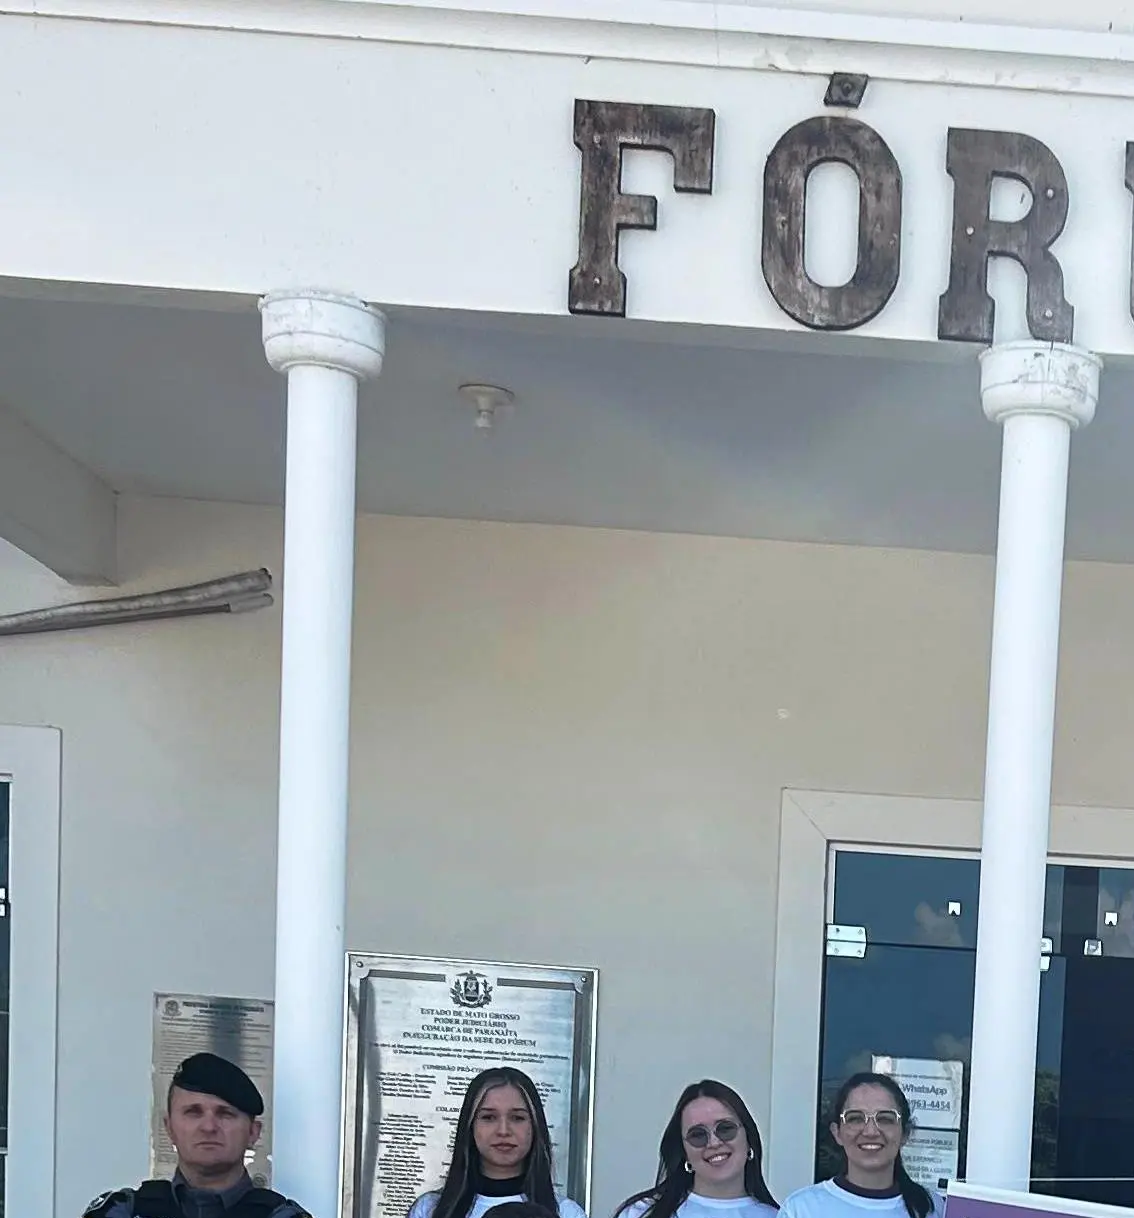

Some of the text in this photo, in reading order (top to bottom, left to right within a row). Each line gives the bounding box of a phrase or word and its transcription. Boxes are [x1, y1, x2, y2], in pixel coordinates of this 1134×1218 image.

[420, 1008, 451, 1017] ESTADO
[466, 1010, 488, 1019] MATO
[489, 1012, 521, 1021] GROSSO
[434, 1017, 507, 1029] PODER JUDICIÁRIO
[421, 1025, 518, 1037] COMARCA DE PARANAÍTA
[462, 1035, 473, 1043] DA
[474, 1036, 493, 1044] SEDE
[508, 1037, 537, 1047] FÓRUM
[902, 1083, 948, 1096] WhatsApp
